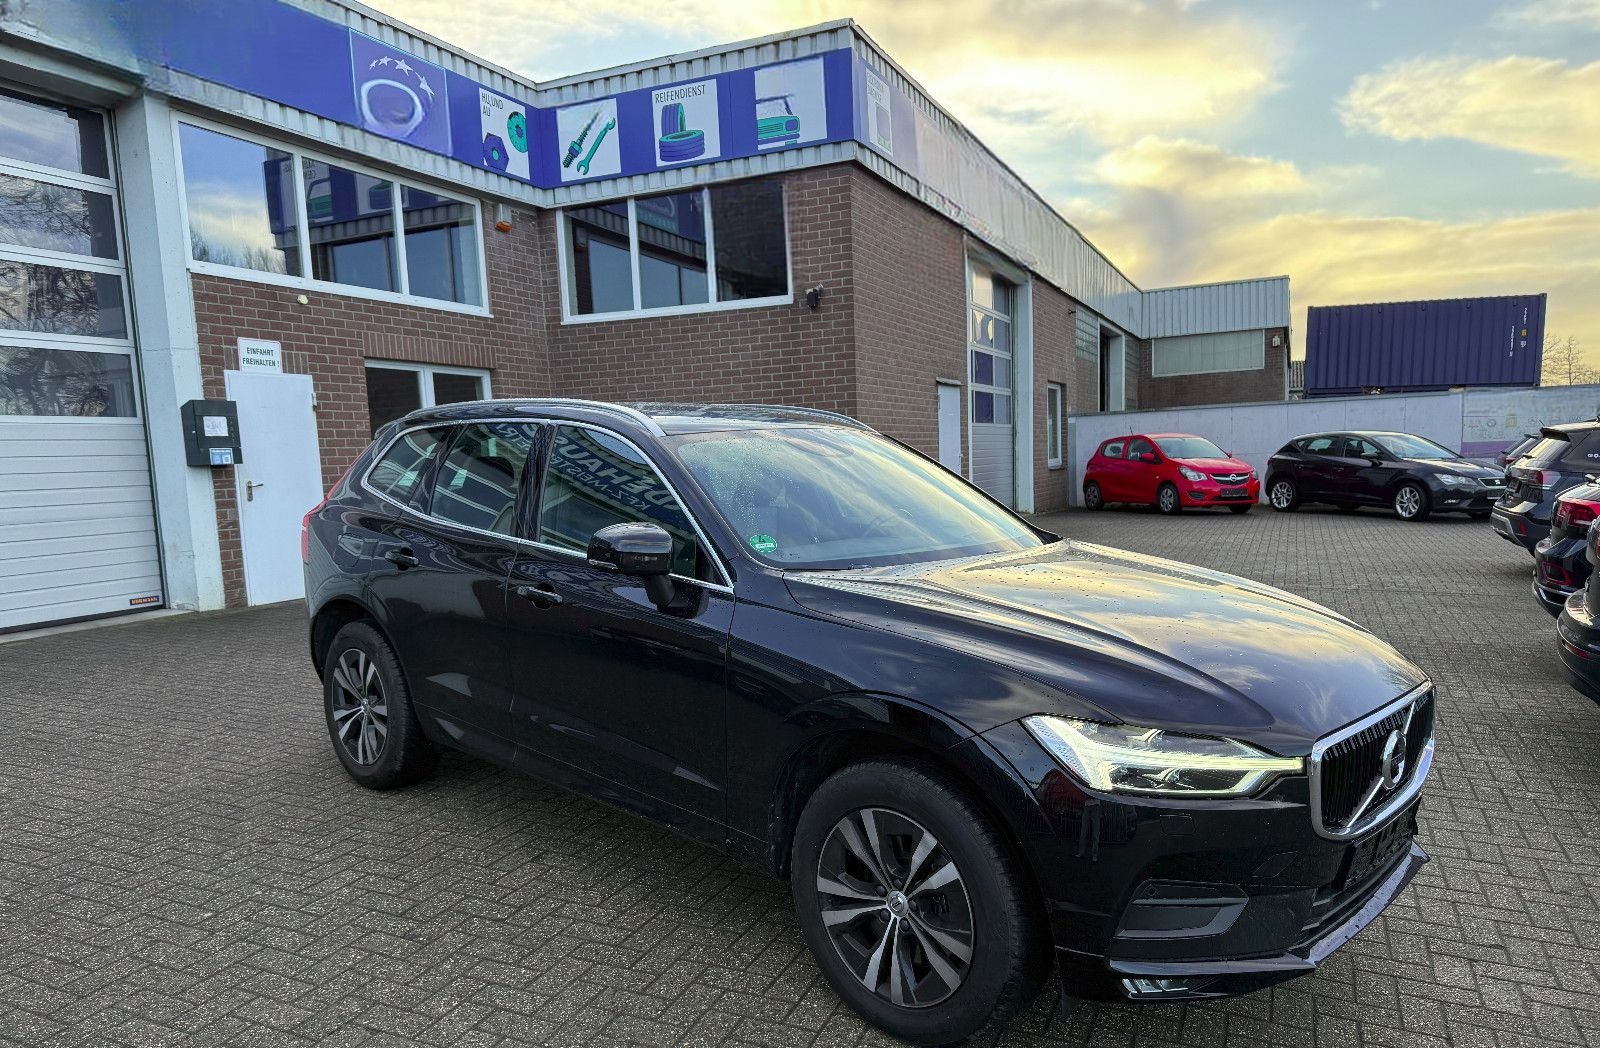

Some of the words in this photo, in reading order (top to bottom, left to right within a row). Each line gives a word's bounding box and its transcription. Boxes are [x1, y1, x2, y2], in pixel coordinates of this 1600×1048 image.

[655, 85, 706, 103] REIFENDIENST
[247, 347, 274, 356] EINFAHRT
[242, 358, 276, 367] FREIHALTEN
